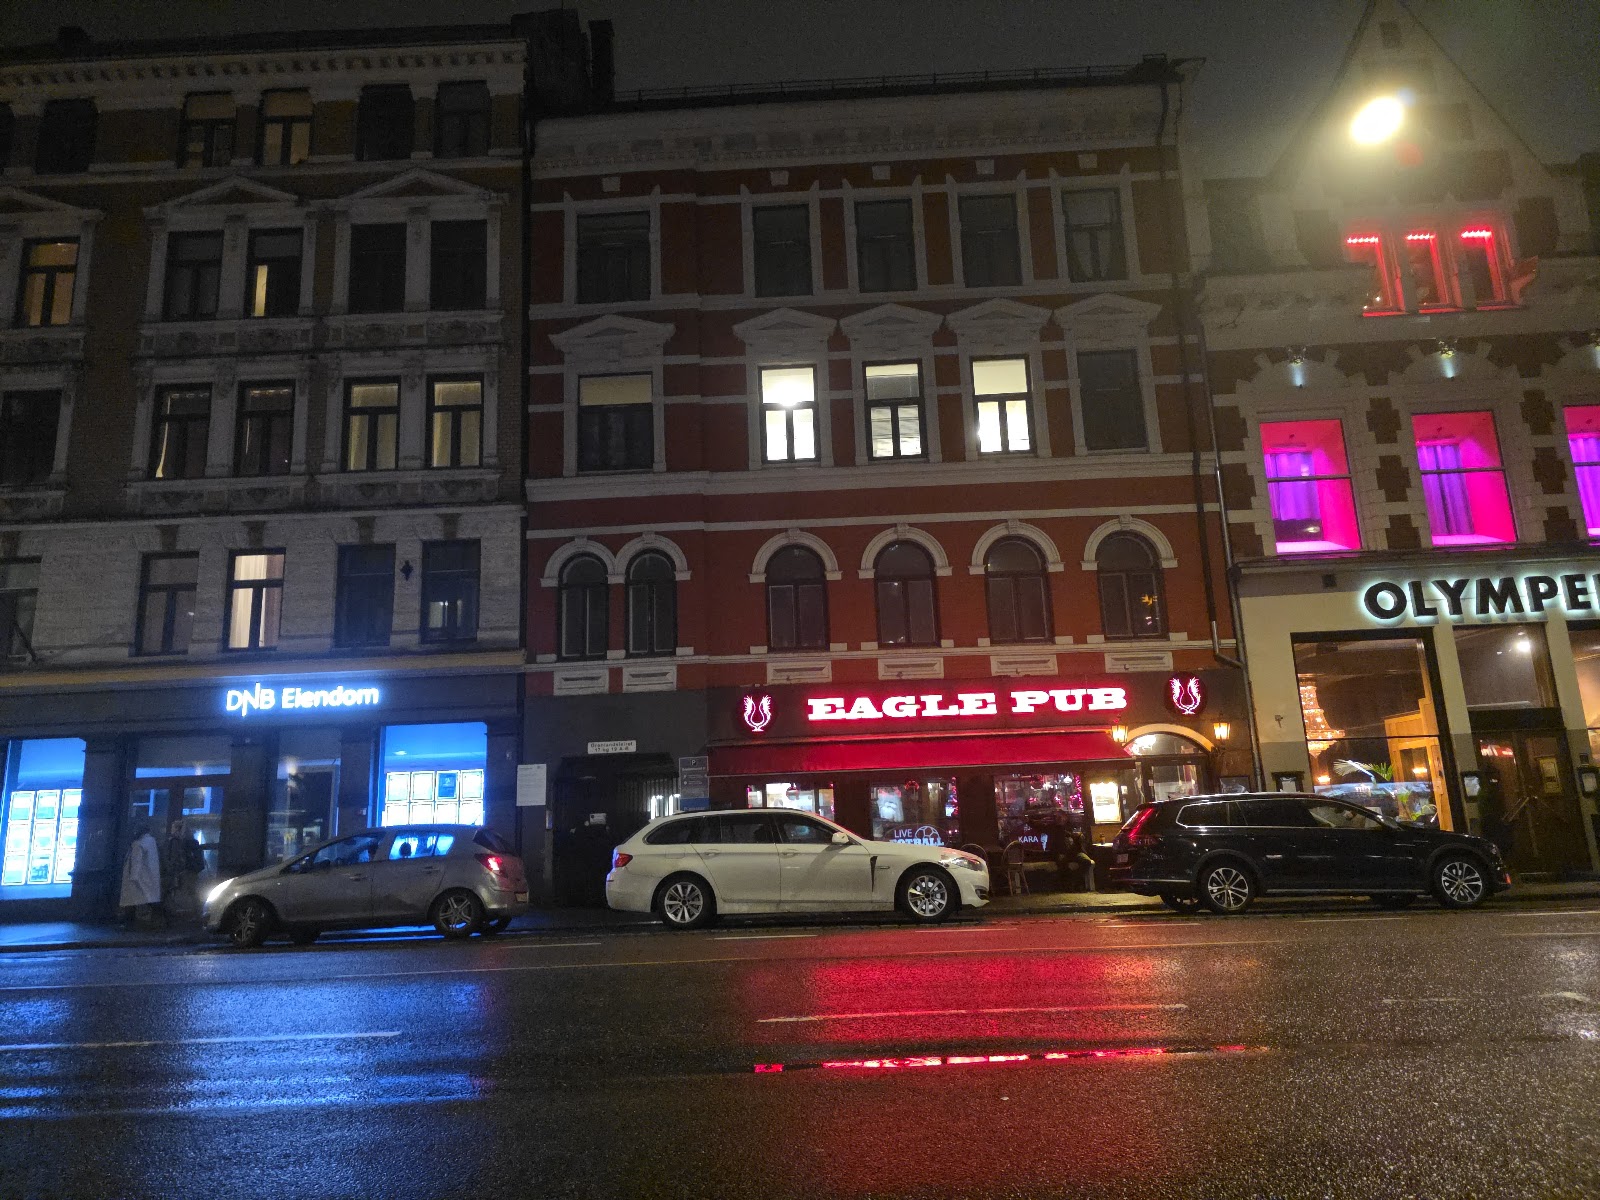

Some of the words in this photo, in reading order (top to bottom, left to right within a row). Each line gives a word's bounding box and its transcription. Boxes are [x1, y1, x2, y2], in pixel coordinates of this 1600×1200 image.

[1364, 574, 1600, 620] OLYMPE
[226, 682, 275, 717] DNB
[282, 685, 380, 709] Eiendom
[807, 692, 997, 721] EAGLE
[1010, 687, 1127, 713] PUB
[894, 828, 913, 838] LIVE
[1018, 835, 1039, 843] KARA
